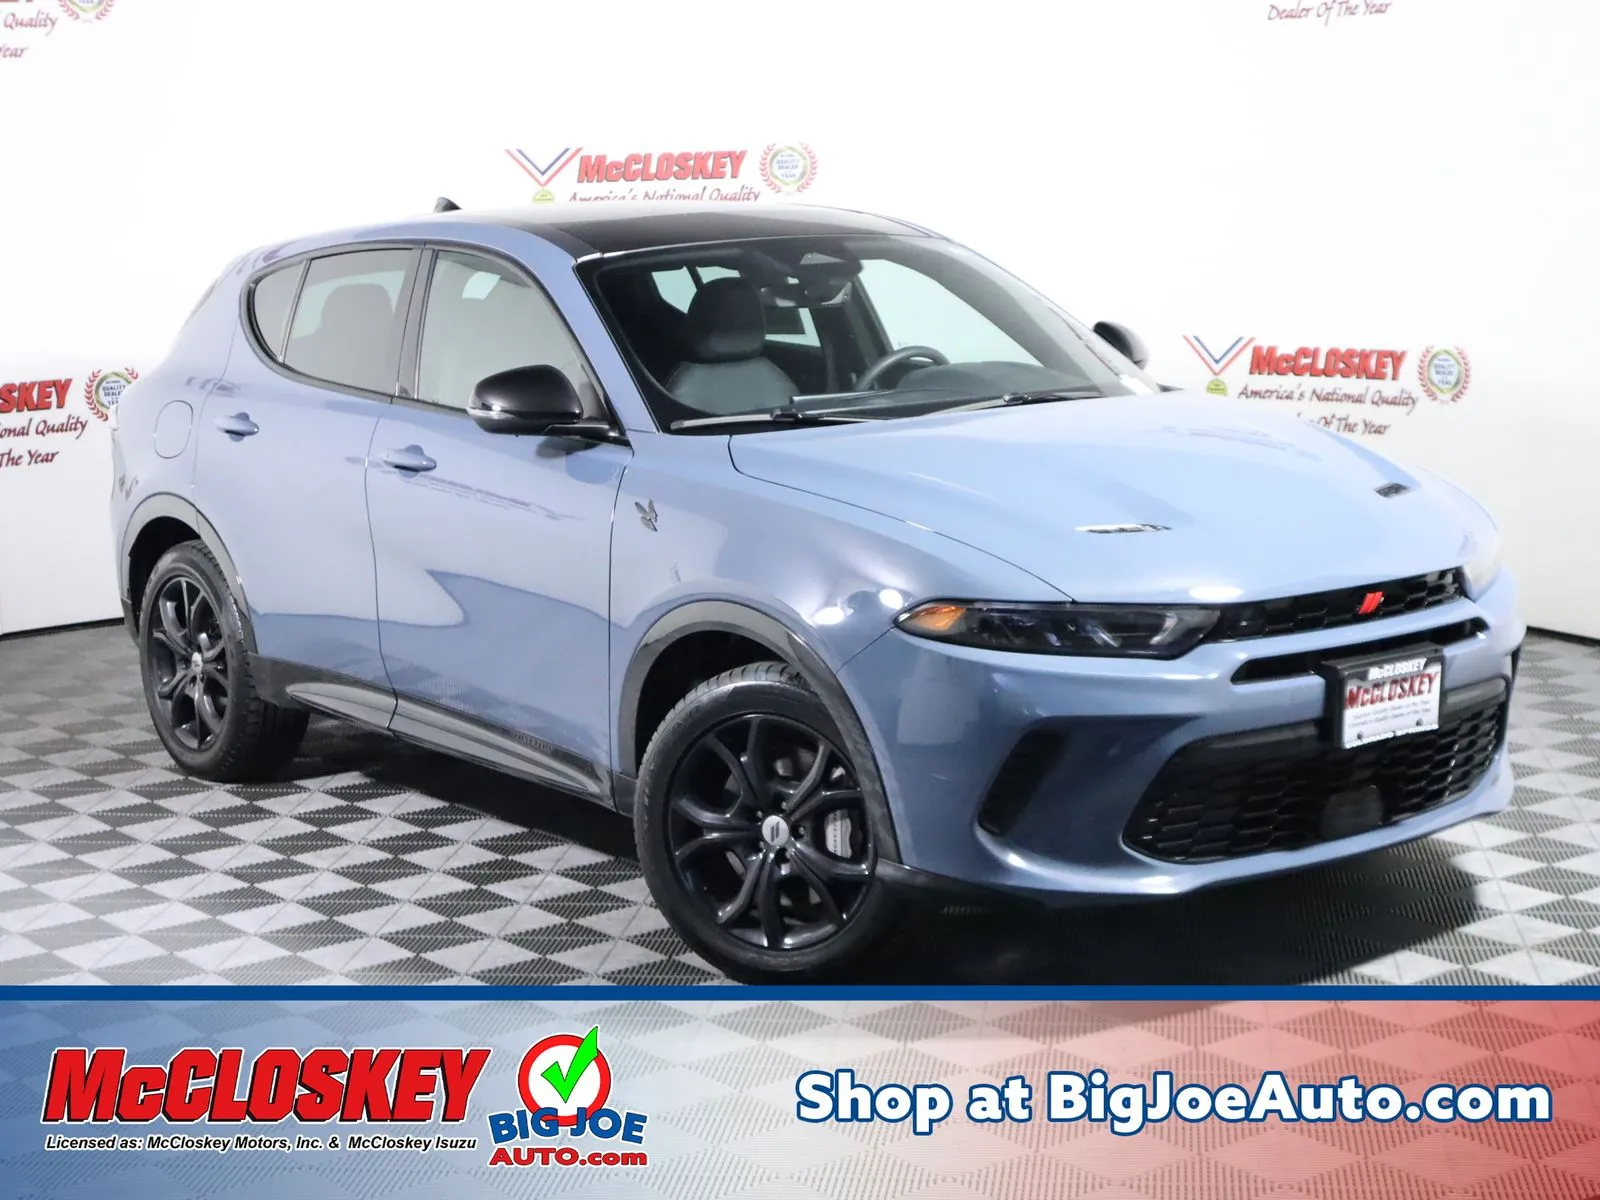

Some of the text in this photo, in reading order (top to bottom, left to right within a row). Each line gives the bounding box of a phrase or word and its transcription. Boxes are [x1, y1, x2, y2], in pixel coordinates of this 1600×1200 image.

[4, 10, 58, 37] Quality
[1268, 0, 1312, 20] Dealer
[1337, 0, 1360, 16] The
[1363, 0, 1392, 16] Year
[577, 150, 748, 183] McCLOSKEY
[1249, 346, 1406, 381] McCLOSKEY
[1238, 383, 1419, 416] America's National Quality
[0, 413, 88, 440] onal Quality
[1336, 413, 1359, 433] The
[1361, 418, 1391, 435] Year
[27, 449, 59, 466] Year
[1368, 657, 1427, 681] McCLOSKEY
[1344, 671, 1438, 710] McCLOSKEY
